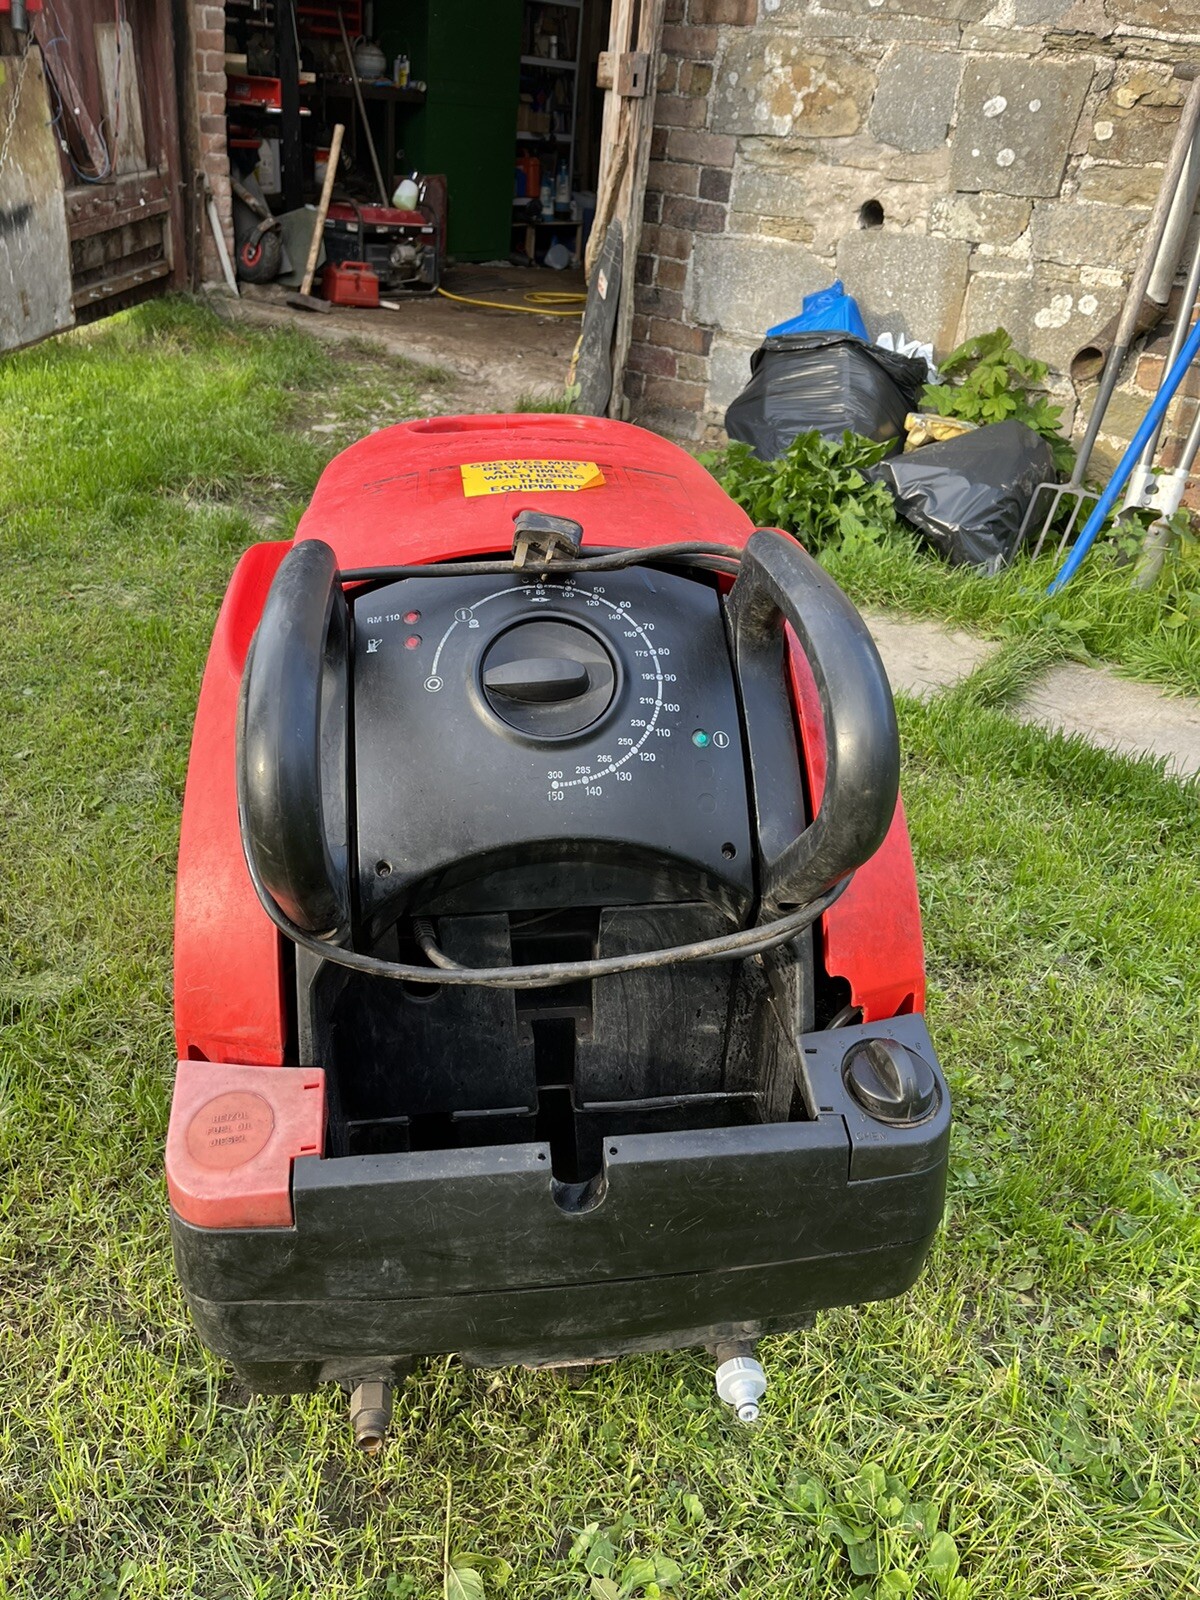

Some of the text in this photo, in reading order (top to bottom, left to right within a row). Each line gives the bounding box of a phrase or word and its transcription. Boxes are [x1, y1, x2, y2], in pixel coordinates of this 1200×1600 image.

[470, 461, 542, 469] GOGGLES
[663, 703, 680, 712] 100
[655, 728, 670, 737] 110
[639, 752, 655, 761] 120
[615, 771, 631, 781] 130
[547, 790, 564, 800] 150
[584, 786, 602, 796] 140
